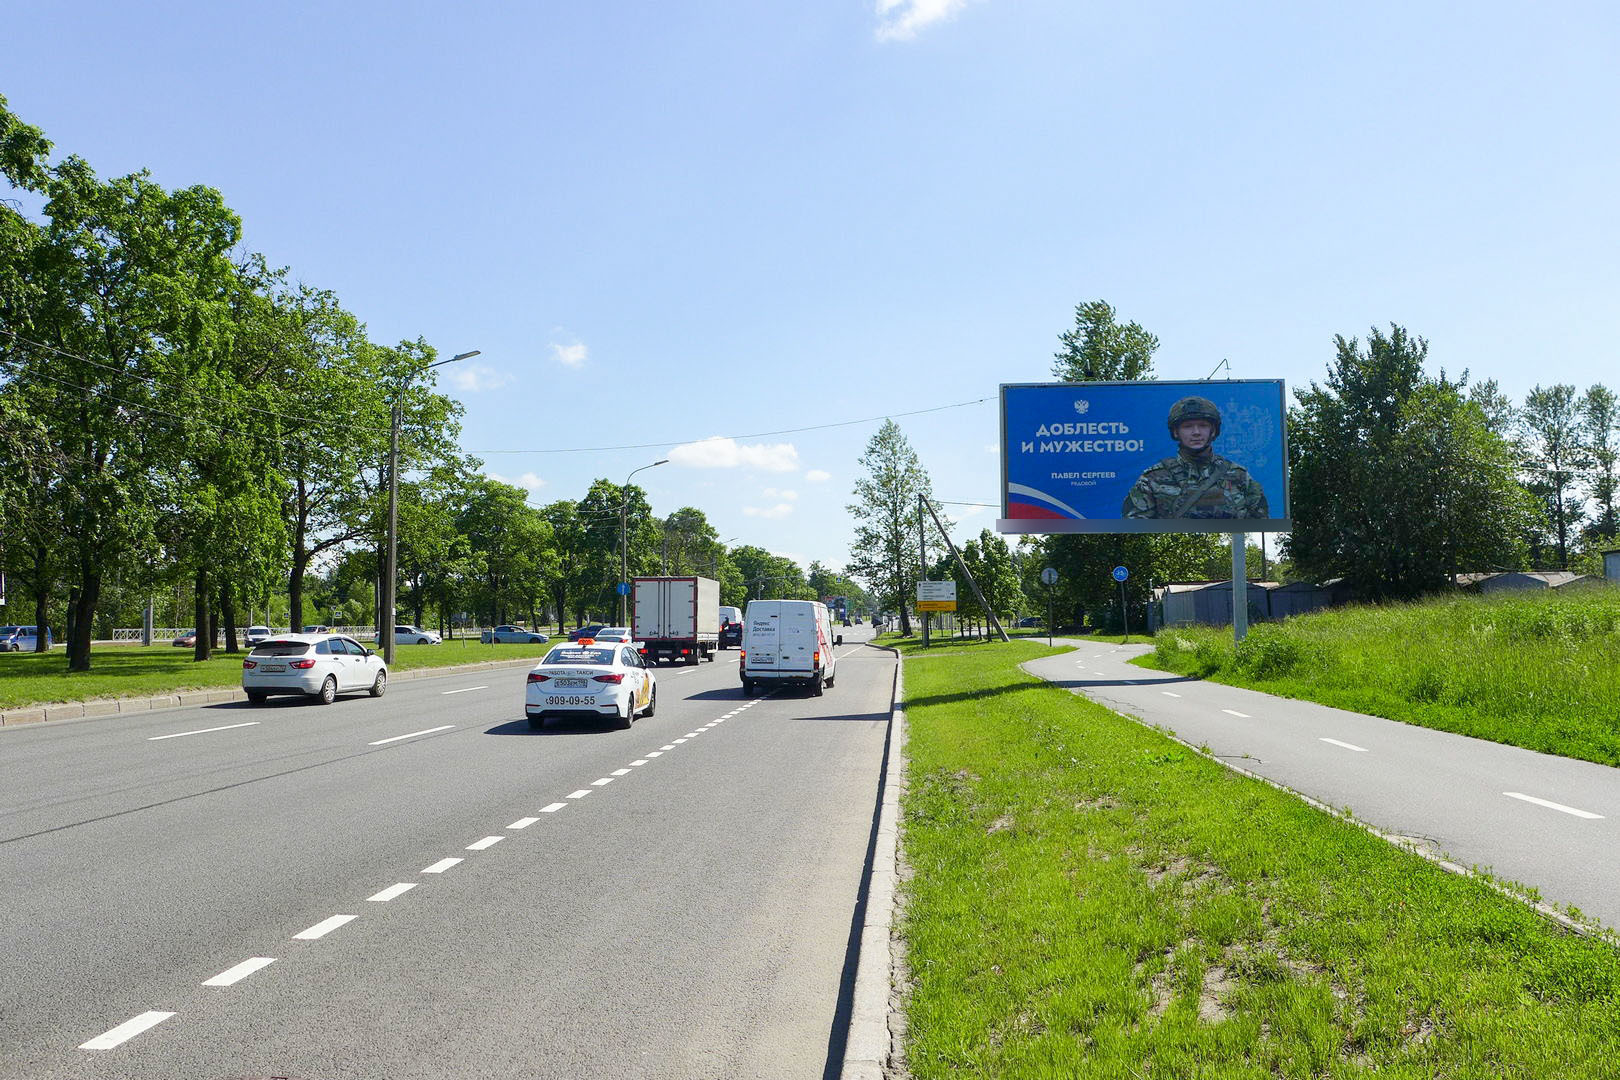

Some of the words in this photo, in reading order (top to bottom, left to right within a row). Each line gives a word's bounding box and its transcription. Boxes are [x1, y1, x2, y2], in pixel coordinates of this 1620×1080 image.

[1036, 422, 1129, 437] ДОБЛЕСТЬ
[1021, 441, 1034, 453] И
[1040, 440, 1144, 453] МУЖЕСТВО!
[1081, 471, 1116, 479] СЕРГЕЕВ
[549, 696, 595, 705] 909-09-55
